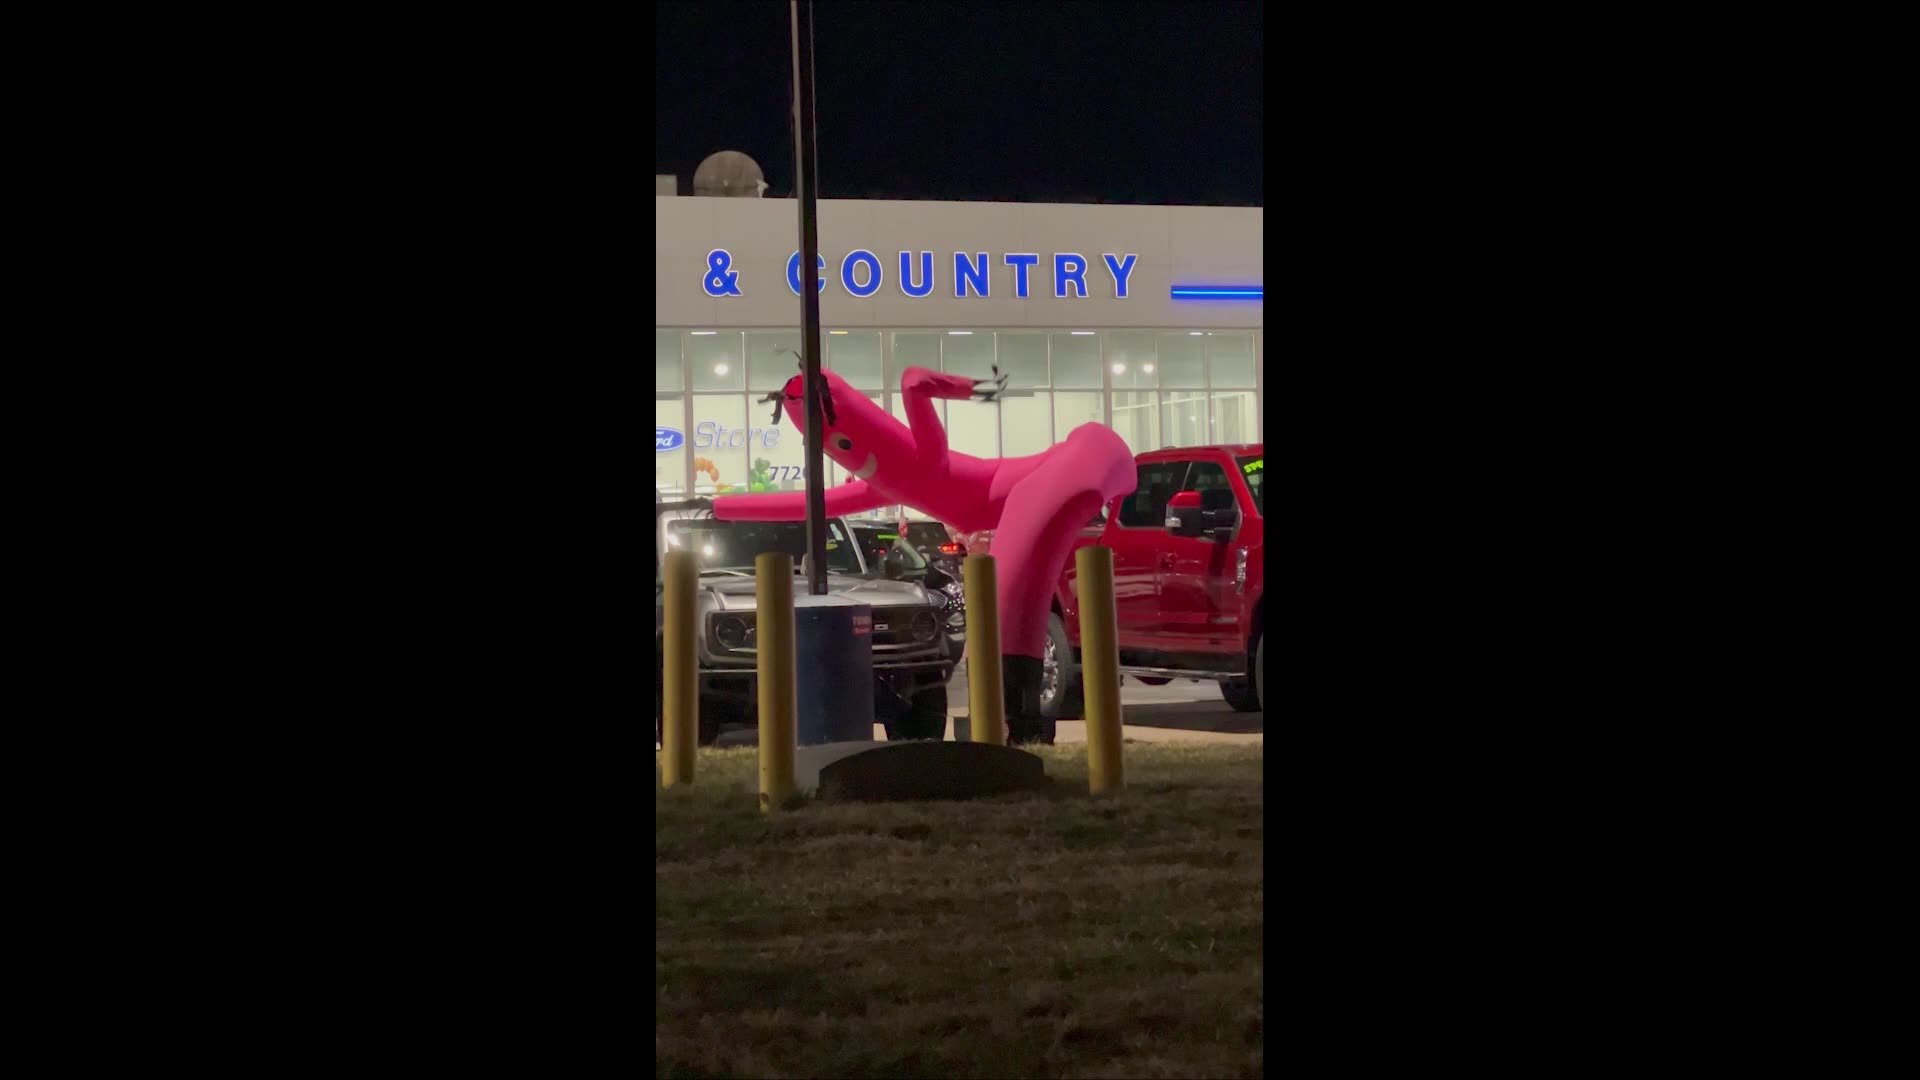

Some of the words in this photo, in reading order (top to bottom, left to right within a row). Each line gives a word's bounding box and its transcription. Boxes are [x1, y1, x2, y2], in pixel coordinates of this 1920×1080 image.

[703, 248, 743, 297] &
[785, 248, 1138, 298] COUNTRY
[692, 421, 780, 448] Store
[769, 466, 806, 481] 772
